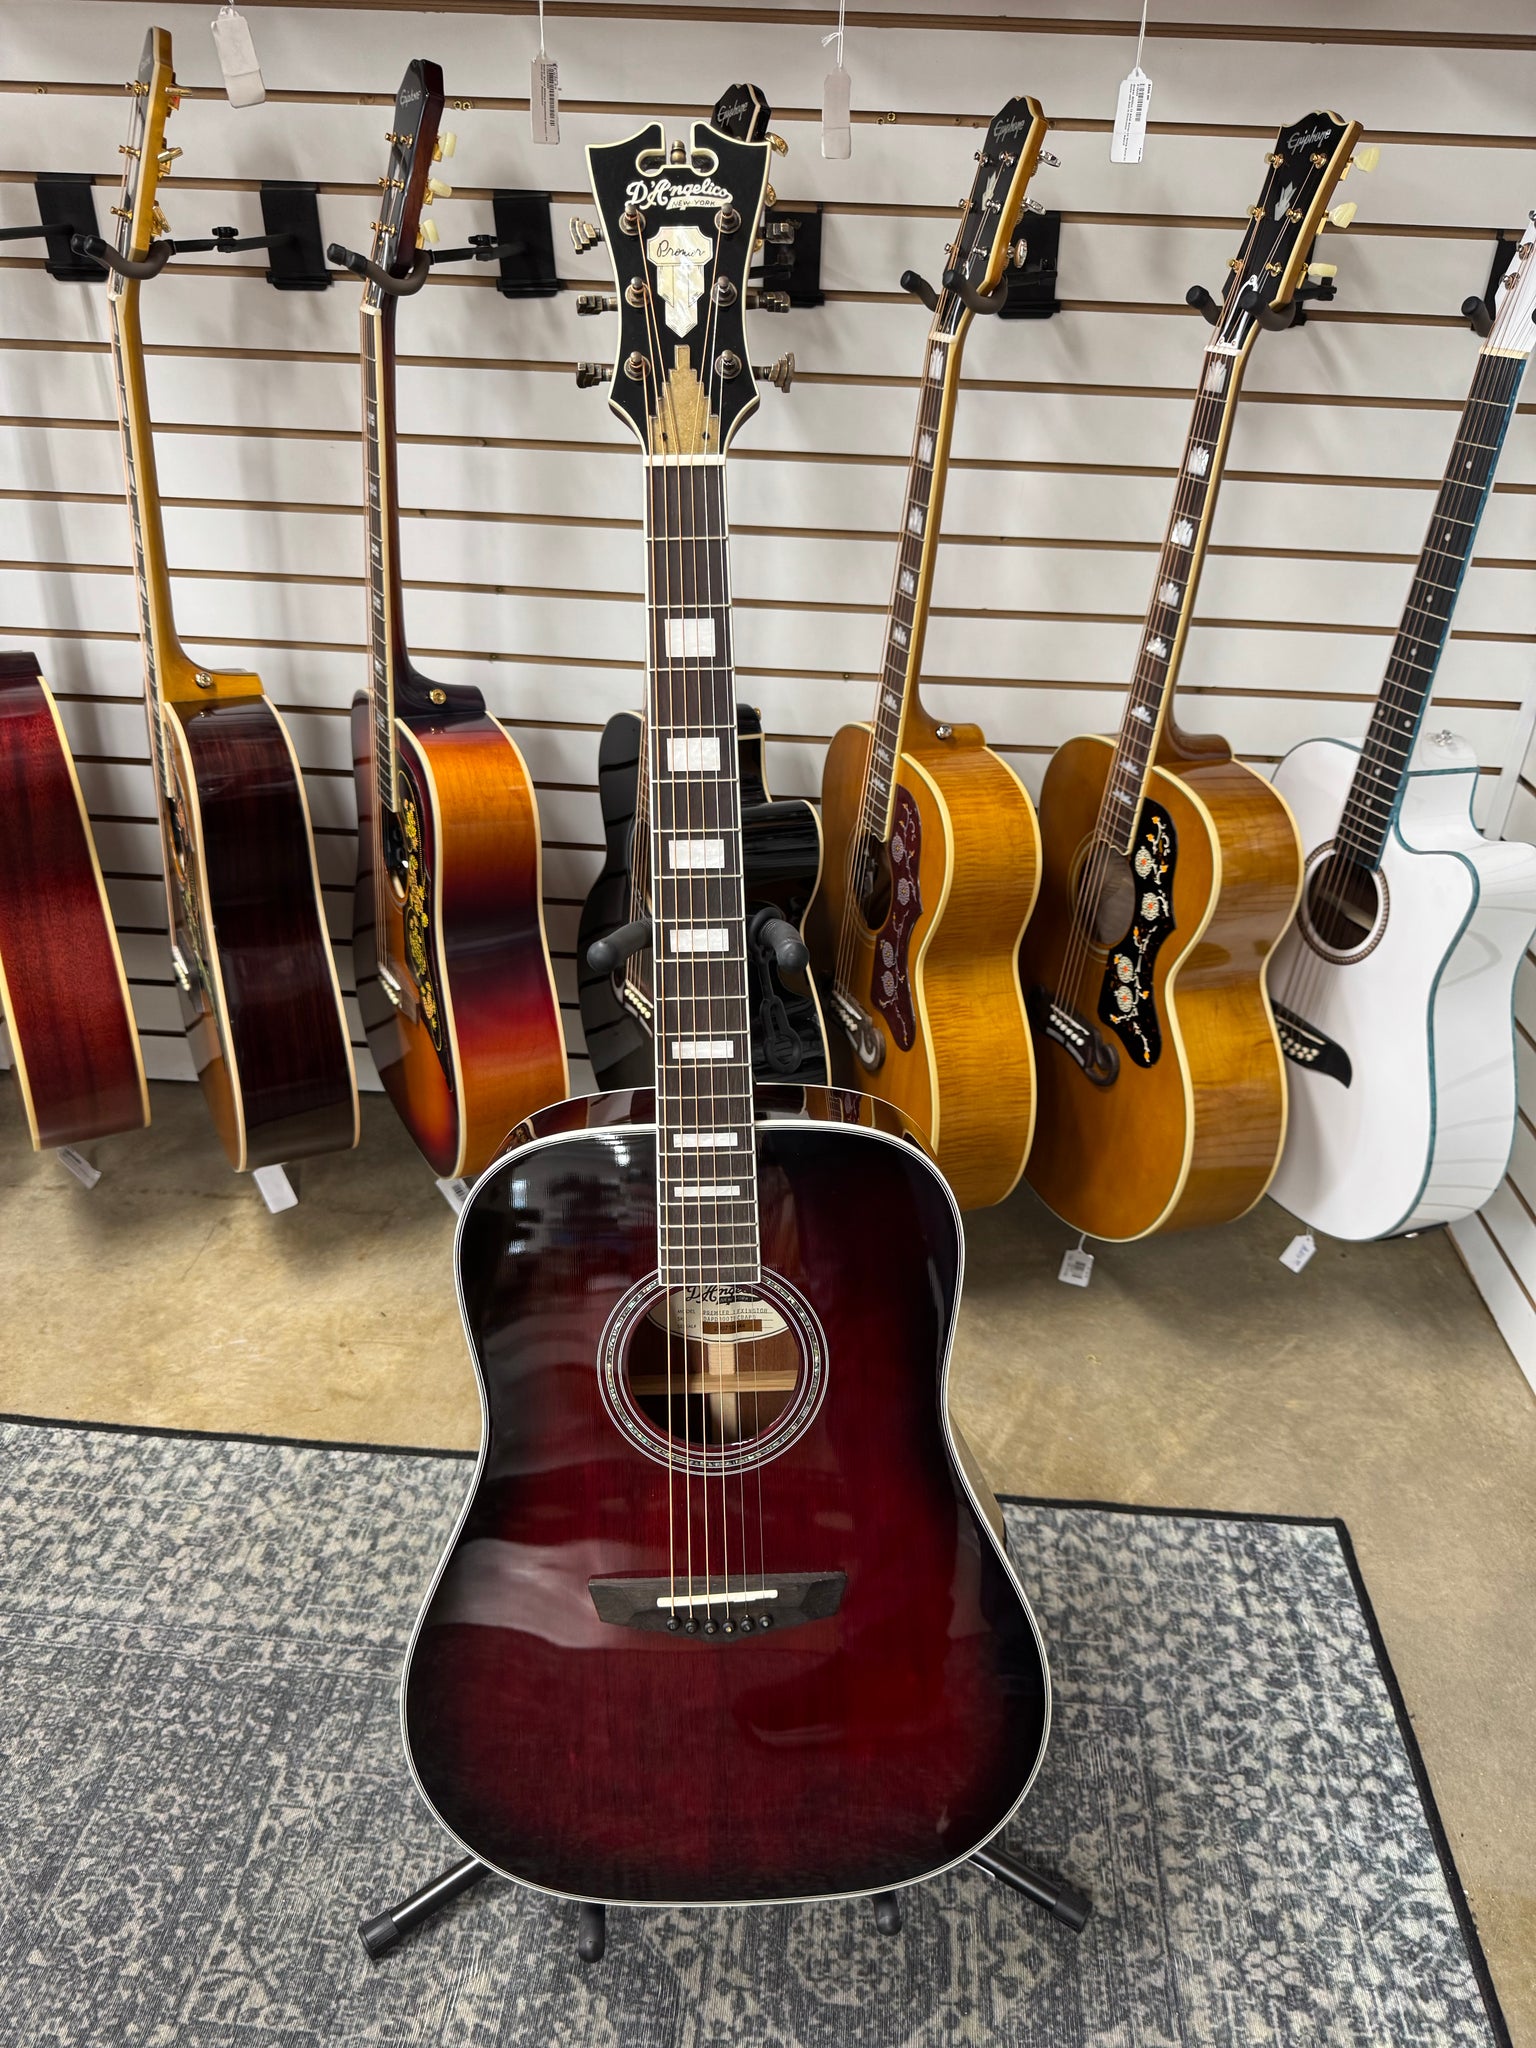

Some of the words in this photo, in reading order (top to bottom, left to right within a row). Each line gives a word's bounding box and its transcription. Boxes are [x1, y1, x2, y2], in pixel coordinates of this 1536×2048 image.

[717, 99, 749, 128] Epiphone
[993, 115, 1025, 143] Epiphone
[1287, 125, 1332, 156] Epiphone
[625, 178, 733, 210] D'Angelico
